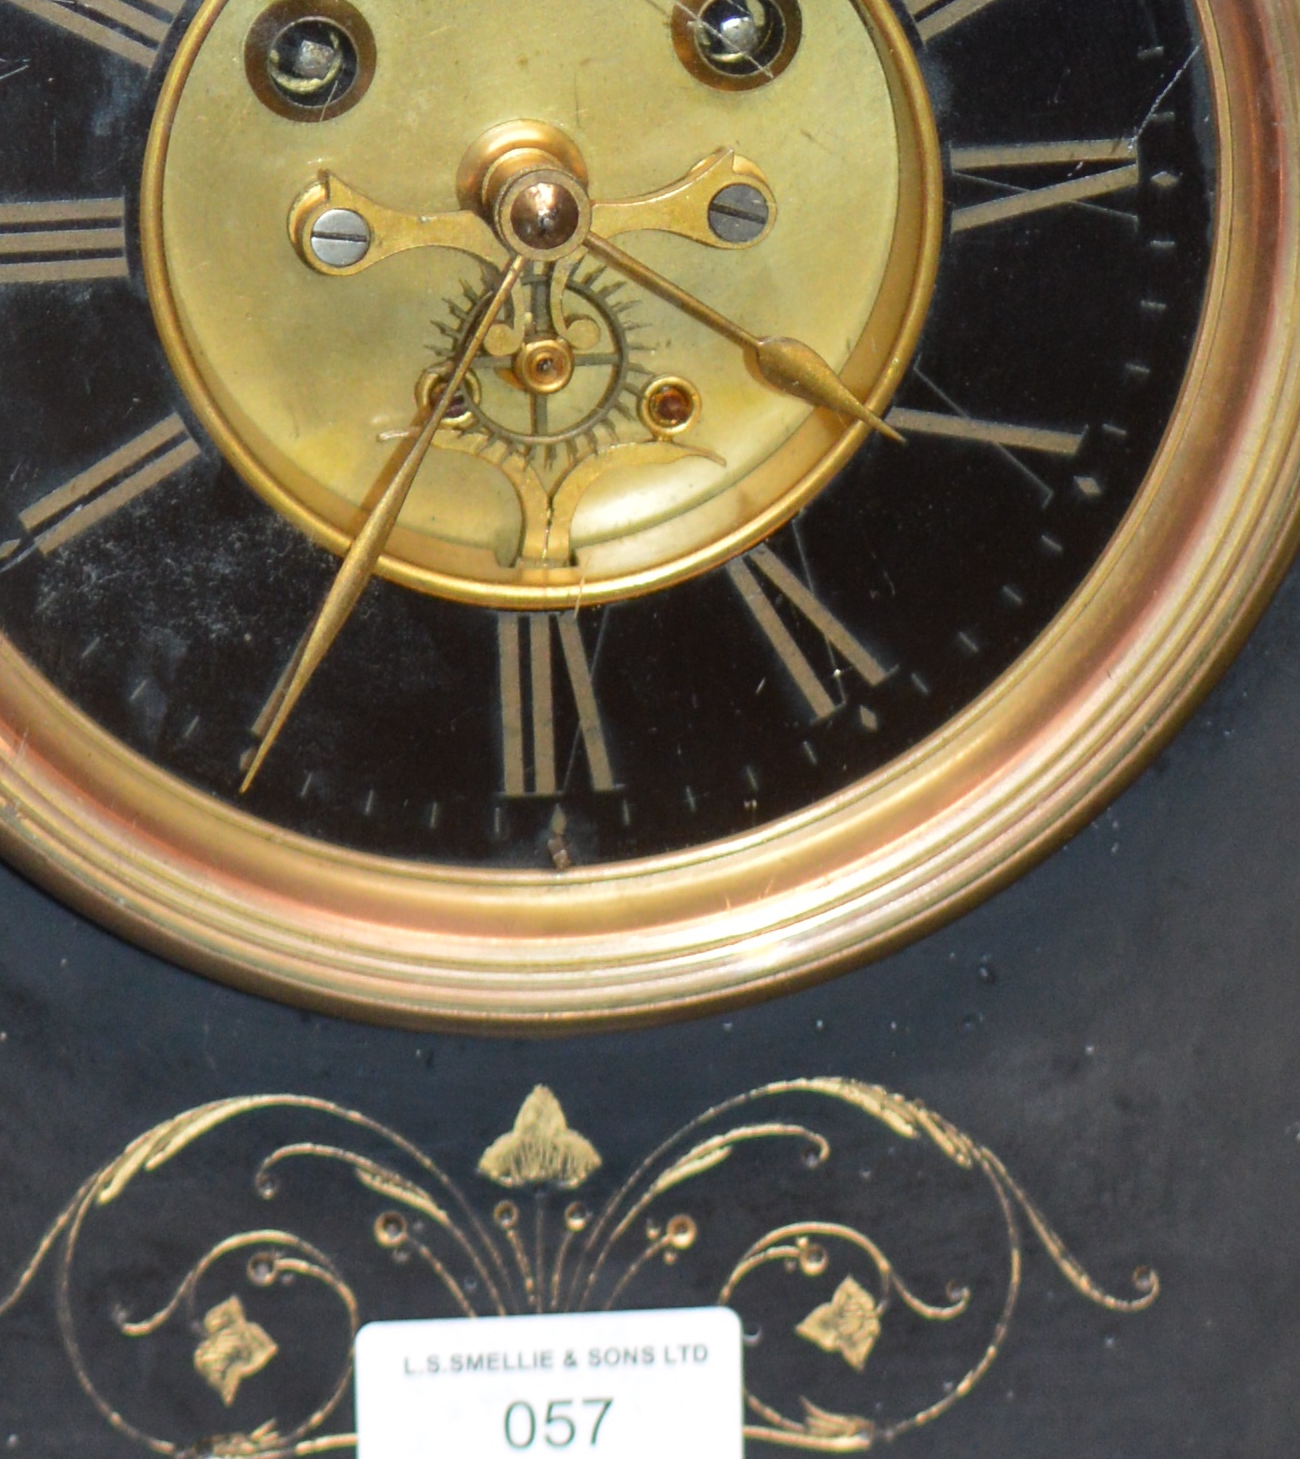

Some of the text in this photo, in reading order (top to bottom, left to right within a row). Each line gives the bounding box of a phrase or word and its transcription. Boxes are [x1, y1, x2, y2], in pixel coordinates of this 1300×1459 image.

[563, 1350, 579, 1369] &
[588, 1346, 656, 1369] SONS
[664, 1343, 710, 1365] LTD
[503, 1396, 615, 1451] 057
